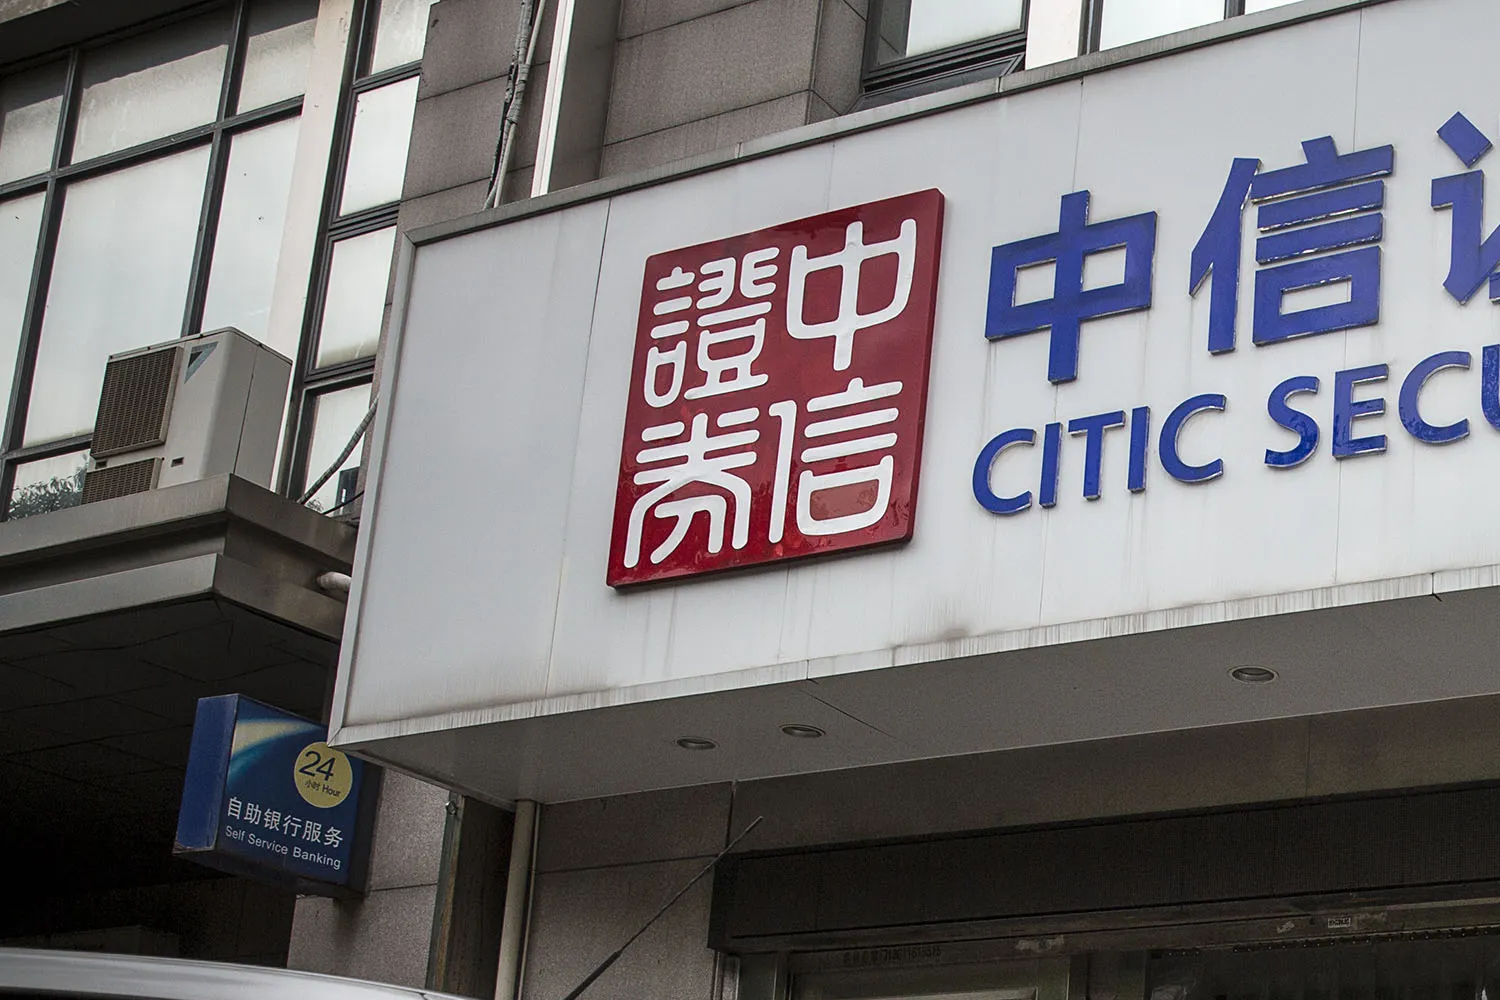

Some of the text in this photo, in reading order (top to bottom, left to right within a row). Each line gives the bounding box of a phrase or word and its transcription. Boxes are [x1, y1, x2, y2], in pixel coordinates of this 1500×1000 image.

[972, 393, 1227, 516] CITIC
[299, 751, 336, 781] 24
[322, 780, 341, 797] Hour
[227, 796, 344, 848] 自助银行服务
[225, 825, 341, 870] Self Service Banking
